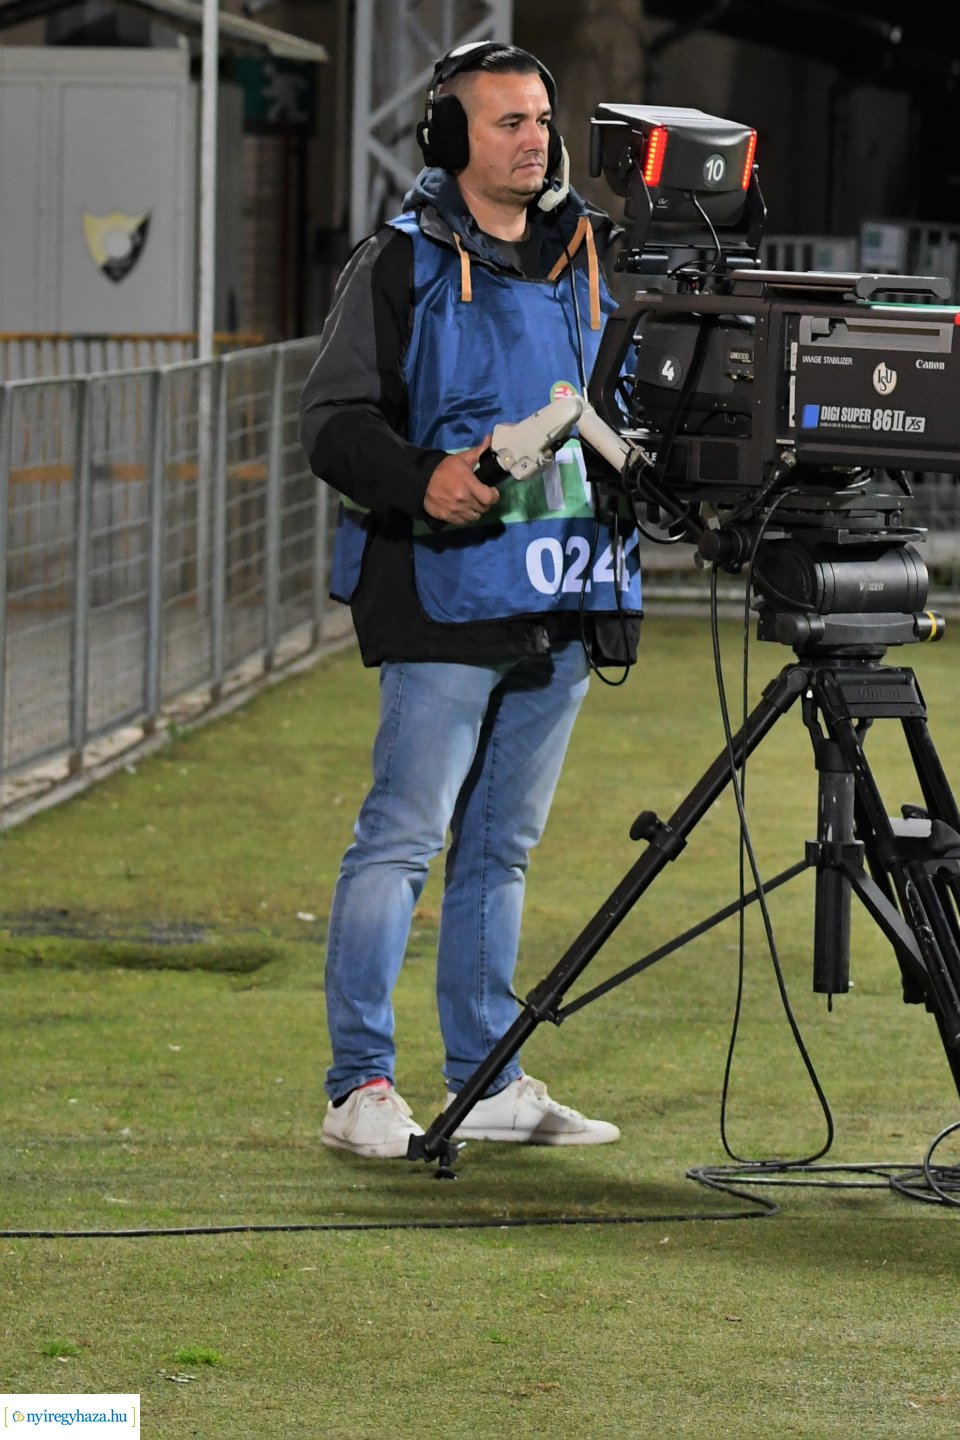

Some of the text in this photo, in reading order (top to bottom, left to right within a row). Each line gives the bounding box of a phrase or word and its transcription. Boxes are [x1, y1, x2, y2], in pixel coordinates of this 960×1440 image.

[705, 159, 724, 181] 10
[661, 359, 675, 381] 4
[802, 354, 853, 366] IMAGE STABILIZER
[915, 358, 945, 370] Canon
[820, 405, 840, 422] DIGI
[841, 407, 872, 423] SUPER
[905, 417, 923, 432] XS
[525, 536, 631, 595] 024
